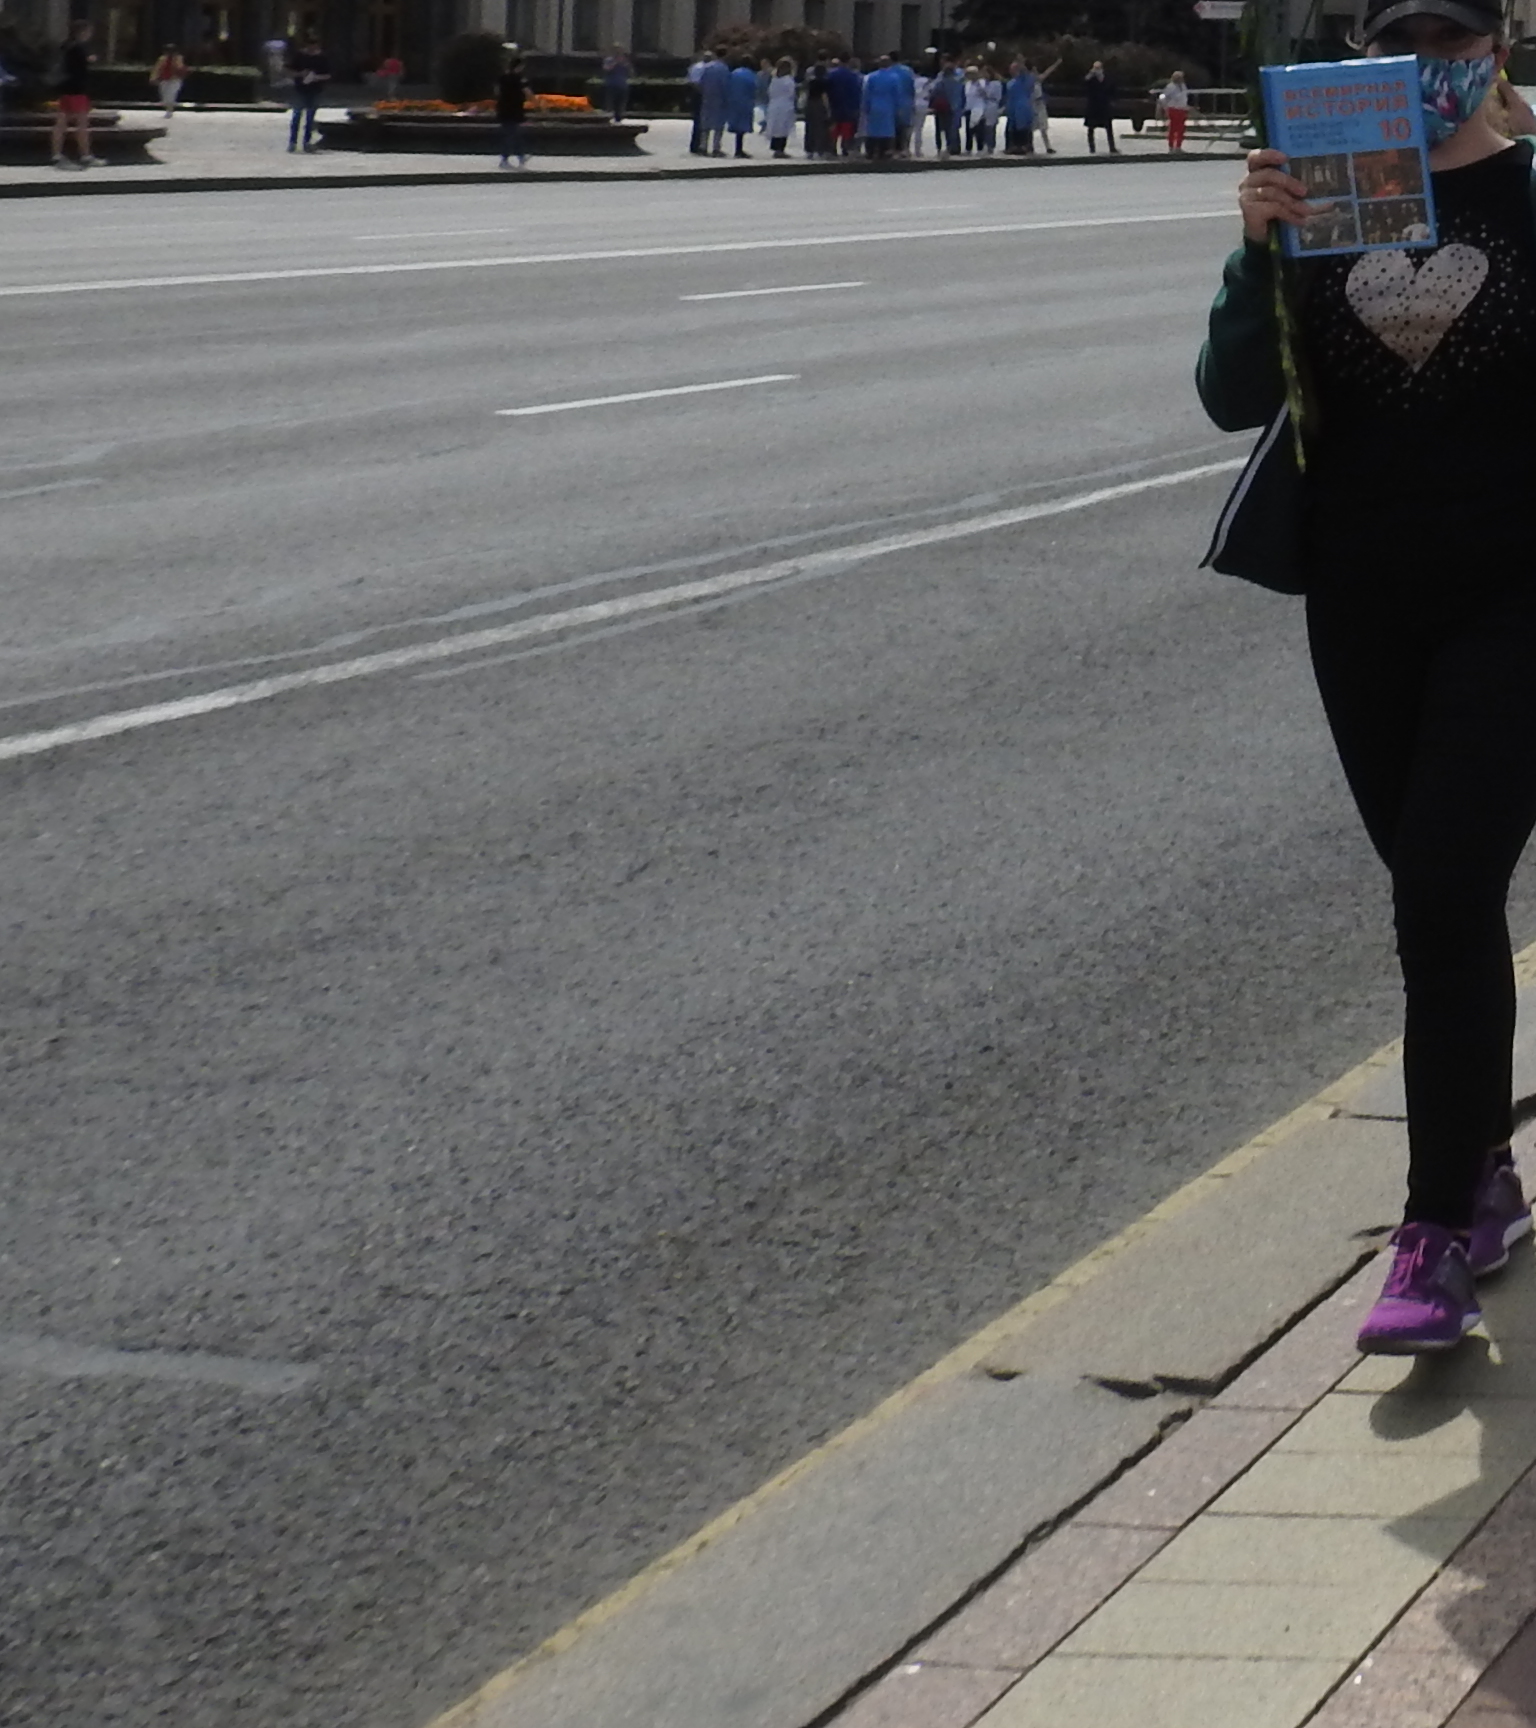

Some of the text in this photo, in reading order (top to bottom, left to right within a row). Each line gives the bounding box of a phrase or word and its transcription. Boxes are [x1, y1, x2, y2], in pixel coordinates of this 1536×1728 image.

[1283, 79, 1407, 103] ВСЕМИРНАЯ
[1285, 94, 1409, 121] ИСТОРИЯ
[1379, 116, 1412, 141] 10
